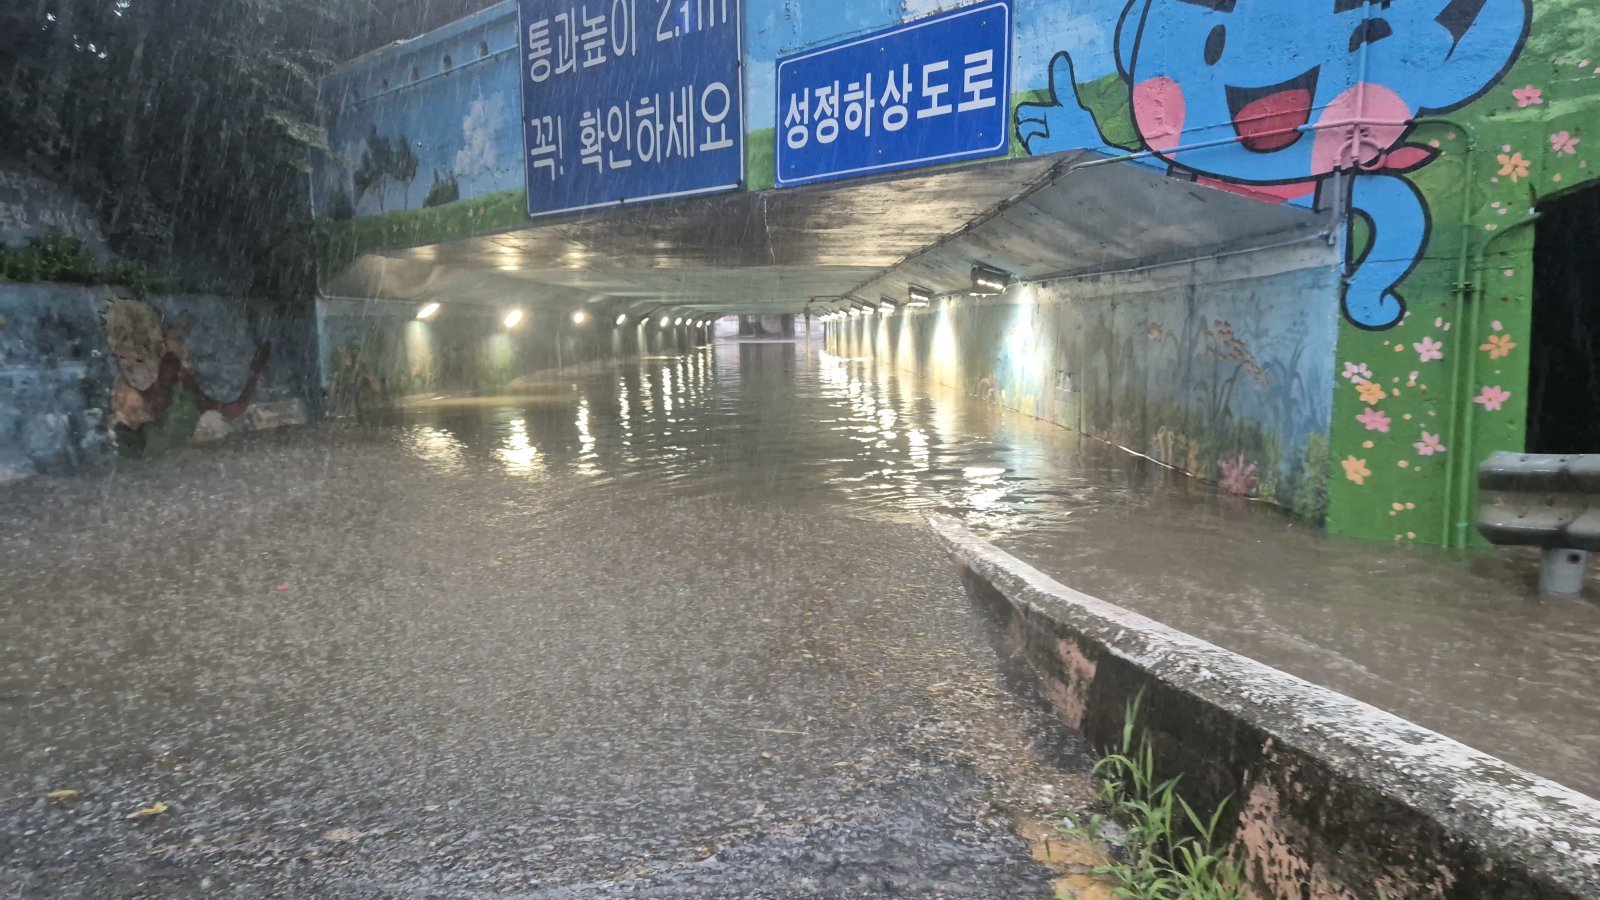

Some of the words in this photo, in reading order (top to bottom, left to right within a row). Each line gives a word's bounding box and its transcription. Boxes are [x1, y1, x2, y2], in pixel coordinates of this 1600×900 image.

[528, 0, 637, 83] 통과높이
[579, 82, 733, 174] 확인하세요
[784, 49, 996, 149] 성정하상도로
